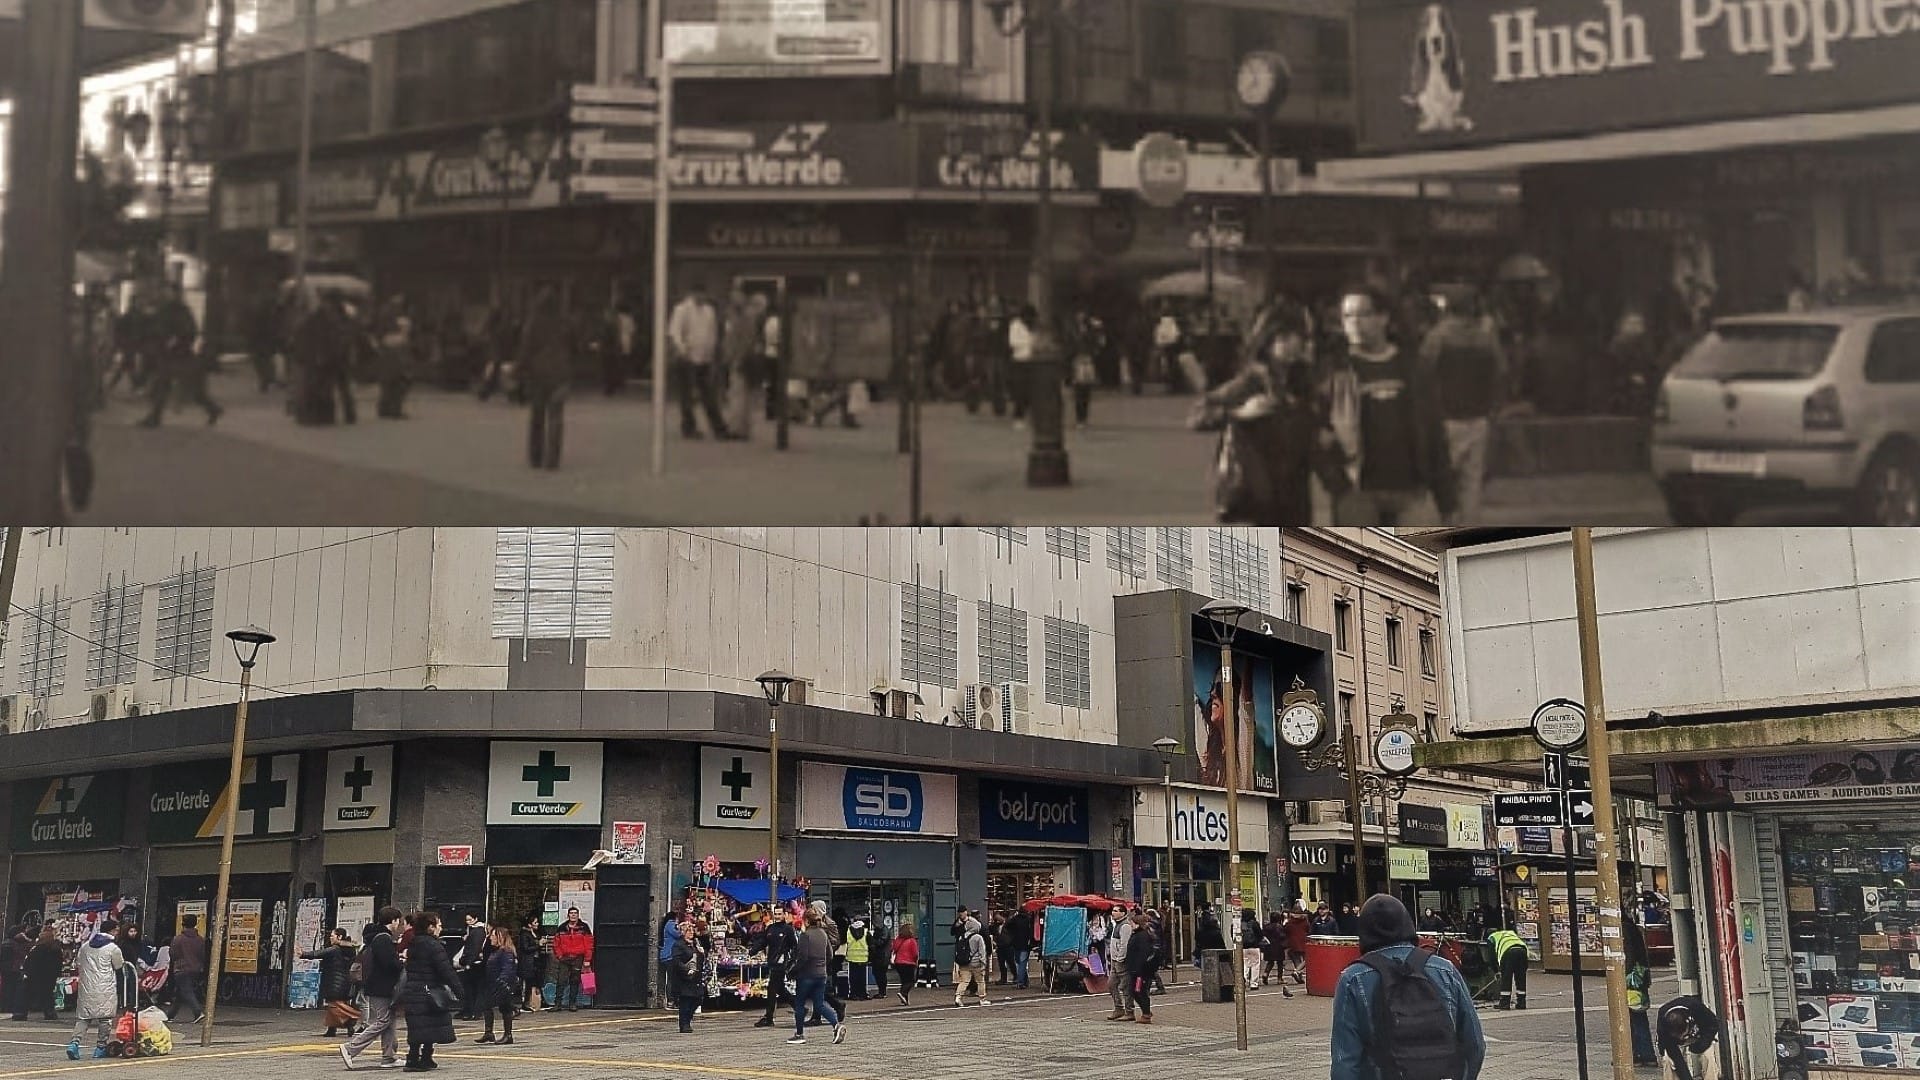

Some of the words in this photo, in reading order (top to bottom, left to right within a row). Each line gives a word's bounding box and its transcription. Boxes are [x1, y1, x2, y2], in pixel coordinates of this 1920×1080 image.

[1490, 0, 1654, 82] Hush
[667, 155, 743, 186] Cruz
[744, 153, 842, 186] Verde
[1256, 771, 1273, 789] hites
[151, 791, 174, 813] Cruz
[175, 789, 209, 810] Verde
[856, 775, 912, 818] sb
[1502, 794, 1528, 804] ANIBAL
[1529, 794, 1552, 803] PINTO
[1744, 790, 1779, 802] SILLAS
[1783, 789, 1820, 801] GAMER
[1832, 786, 1893, 798] AUDIFONOS
[341, 808, 354, 818] Cruz
[354, 808, 369, 818] Verde
[519, 803, 538, 814] Cruz
[539, 803, 566, 814] Verde
[721, 807, 734, 816] Cruz
[734, 807, 752, 817] Verde
[999, 790, 1077, 831] belsport
[1174, 794, 1228, 842] hites
[31, 819, 57, 842] Cruz
[58, 817, 92, 840] Verde
[858, 818, 911, 828] SALCOBRAND
